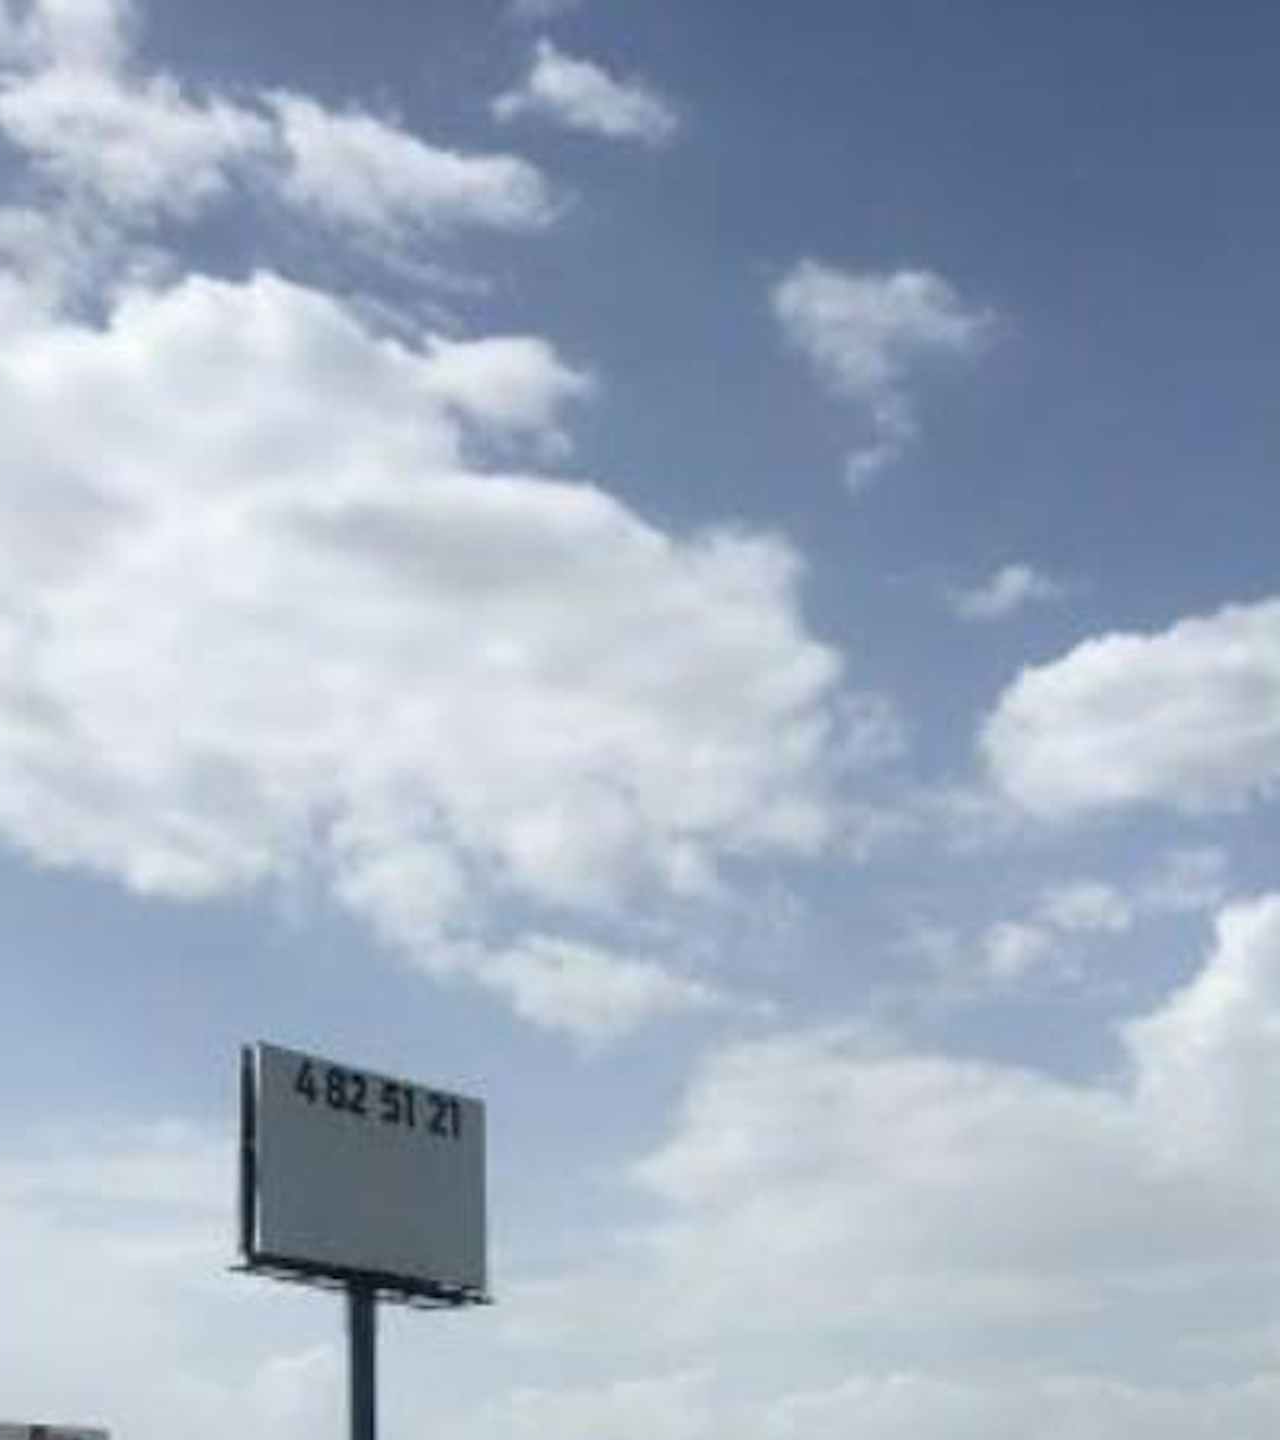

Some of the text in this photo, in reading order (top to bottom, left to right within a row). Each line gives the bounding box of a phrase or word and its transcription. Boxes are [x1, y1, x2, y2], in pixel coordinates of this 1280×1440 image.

[296, 1057, 461, 1138] 4 82 51 21
